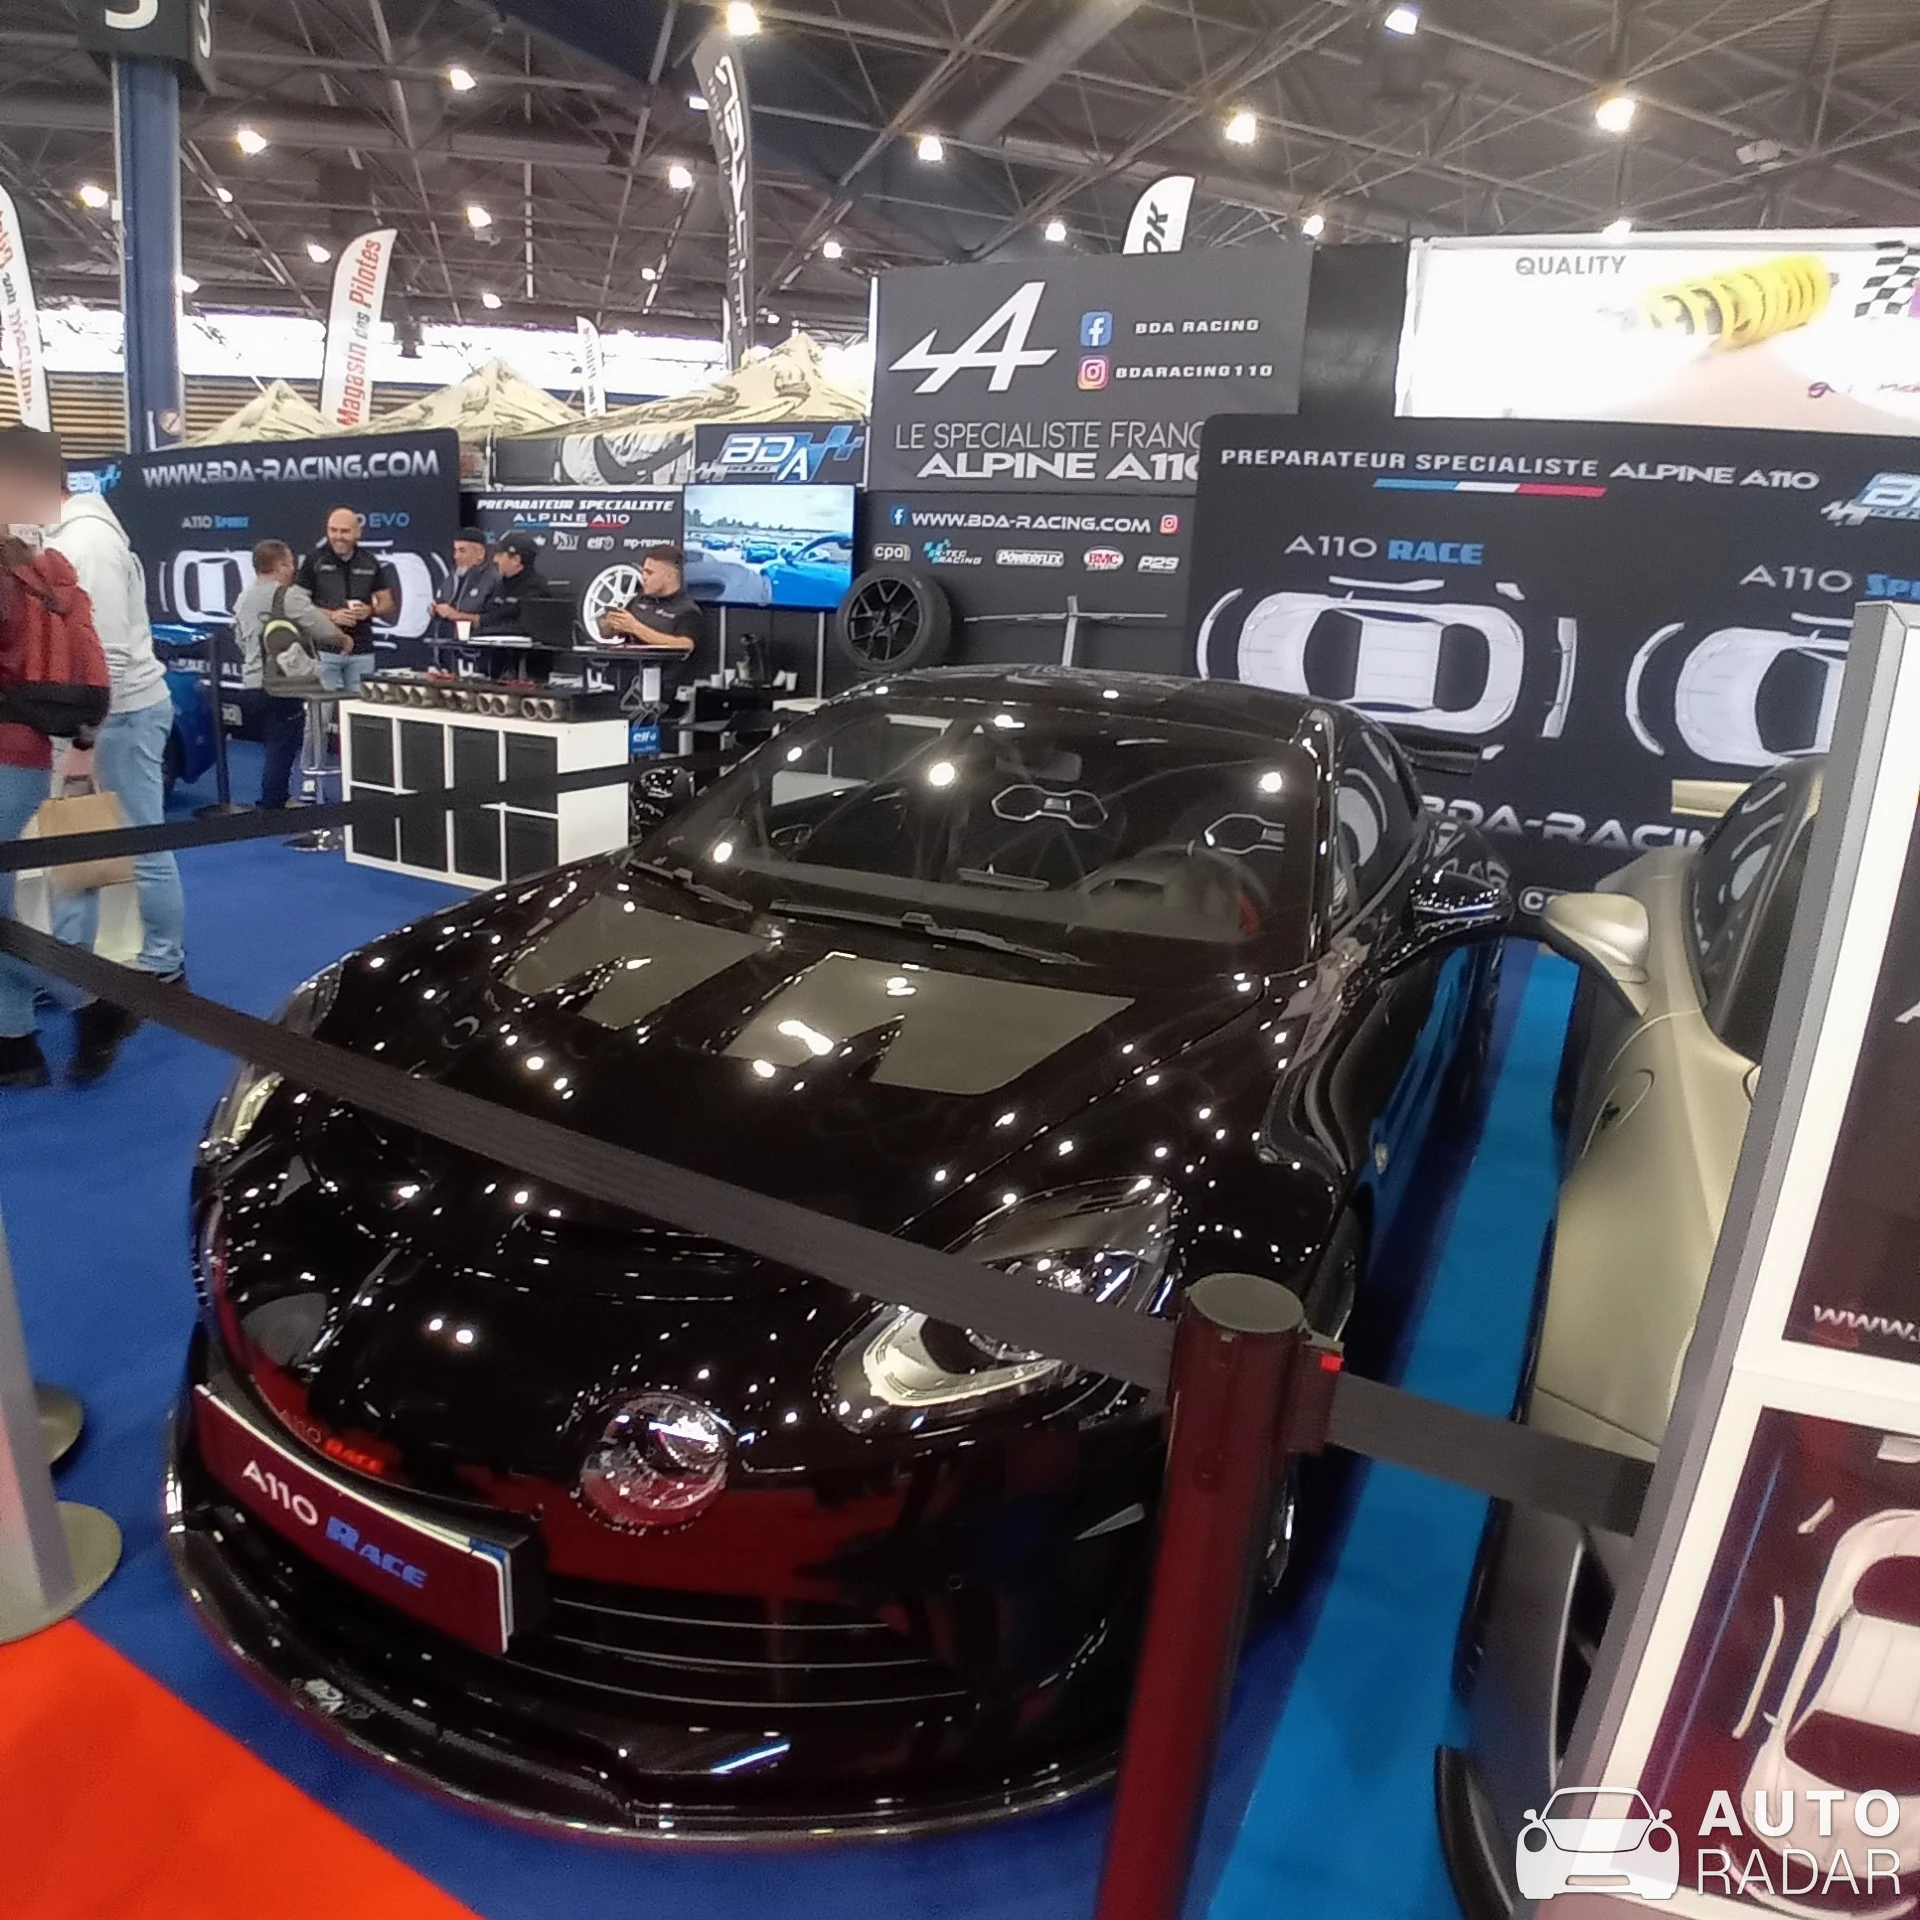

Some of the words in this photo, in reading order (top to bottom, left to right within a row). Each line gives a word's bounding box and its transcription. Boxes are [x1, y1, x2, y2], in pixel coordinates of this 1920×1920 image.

[349, 239, 382, 309] Pilotes
[1515, 255, 1627, 276] QUALITY
[1135, 322, 1175, 335] BDA
[1182, 319, 1260, 334] RACING
[336, 343, 368, 427] Magasin
[896, 423, 926, 449] LE
[933, 421, 1101, 449] SPECIALISTE
[142, 449, 440, 489] WWW.BDA-RACING.COM
[916, 452, 1098, 479] ALPINE
[1221, 449, 1406, 469] PREPARATEUR
[1415, 454, 1599, 477] SPECIALISTE
[1609, 462, 1736, 485] ALPINE
[1739, 469, 1821, 490] A110
[368, 512, 411, 528] EVO
[476, 500, 575, 511] PREPARATEUR
[578, 500, 675, 512] SPECIALISTE
[513, 512, 588, 523] ALPINE
[592, 513, 631, 524] A110
[912, 512, 1151, 534] WWW.BDA-RACING.COM
[1284, 534, 1378, 558] A110
[1387, 539, 1485, 565] RACE
[1739, 564, 1854, 593] A110
[1814, 1304, 1920, 1344] www.
[242, 1459, 318, 1527] A110
